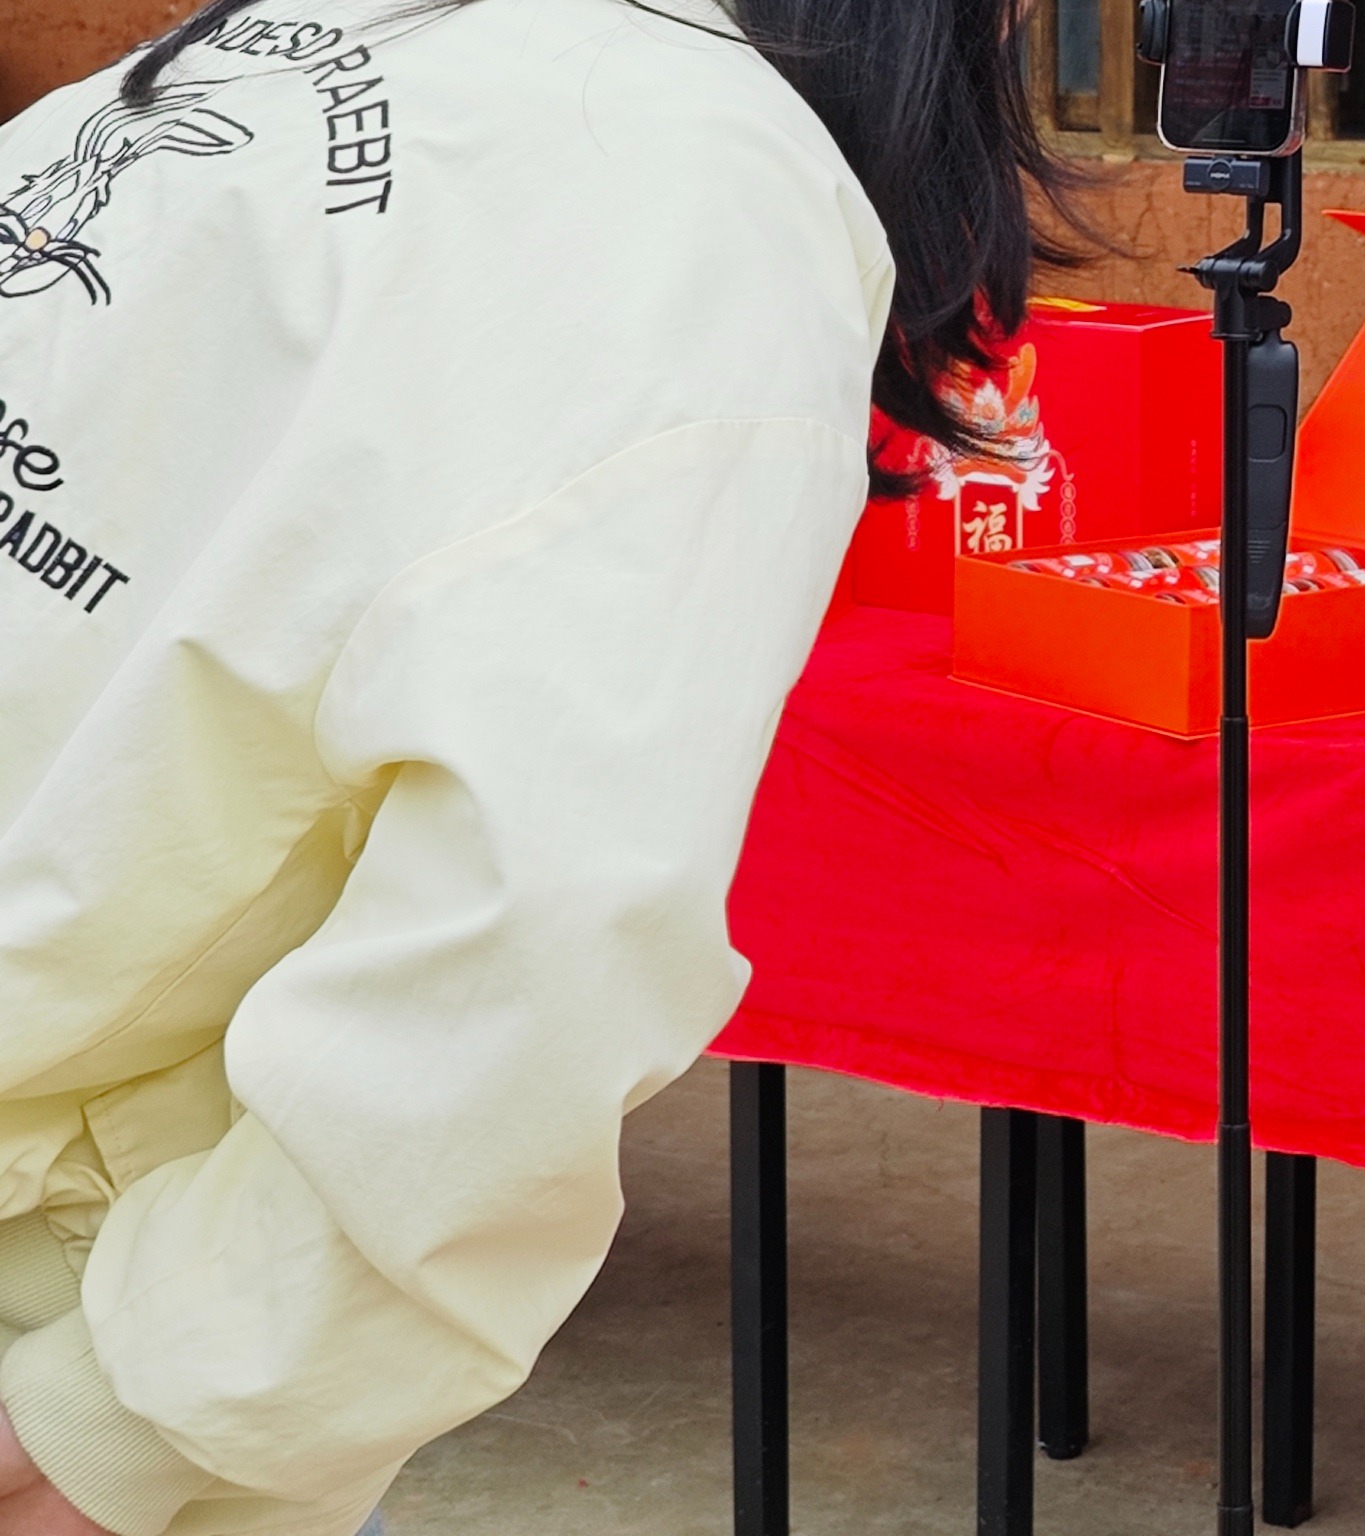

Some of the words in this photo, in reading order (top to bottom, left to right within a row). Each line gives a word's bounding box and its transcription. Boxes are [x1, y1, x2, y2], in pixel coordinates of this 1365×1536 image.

[303, 45, 392, 215] RAEBIT
[0, 399, 64, 491] fe
[964, 501, 1012, 553] 福
